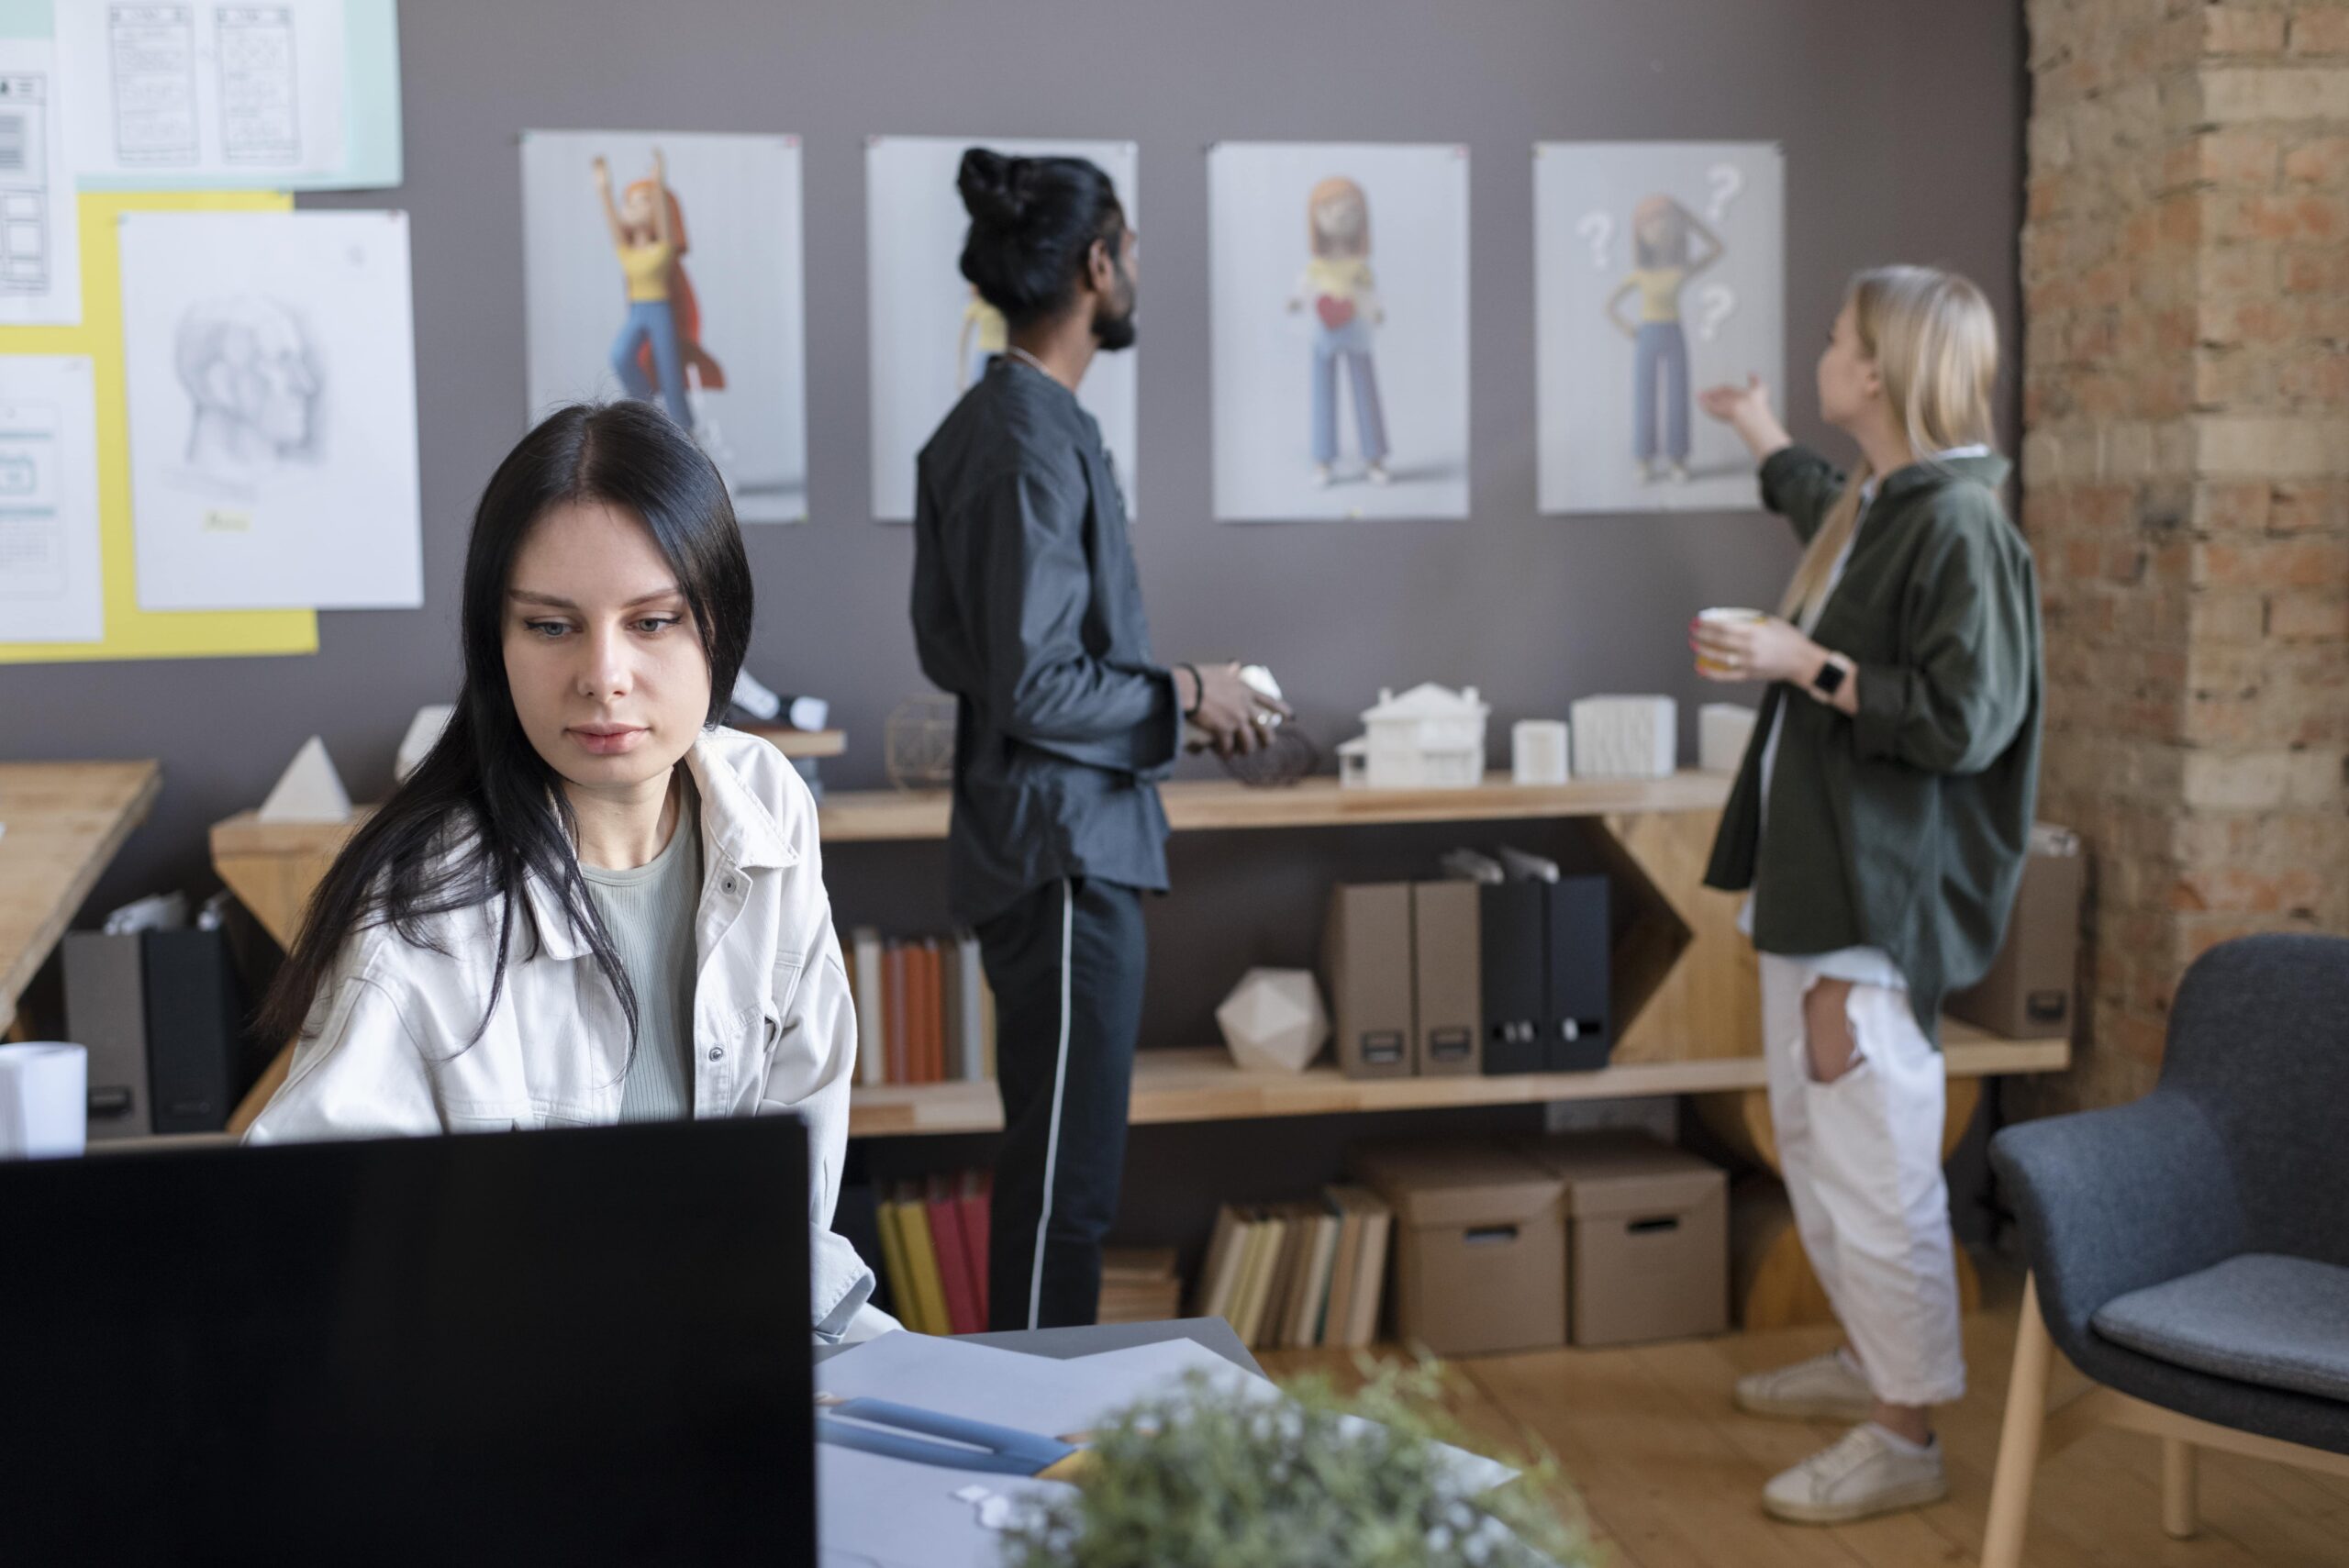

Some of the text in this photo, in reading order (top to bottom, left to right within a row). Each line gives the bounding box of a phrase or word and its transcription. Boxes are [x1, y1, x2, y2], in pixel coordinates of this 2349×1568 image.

[1708, 163, 1742, 221] ?
[1575, 211, 1612, 268] ?
[1700, 284, 1734, 340] ?
